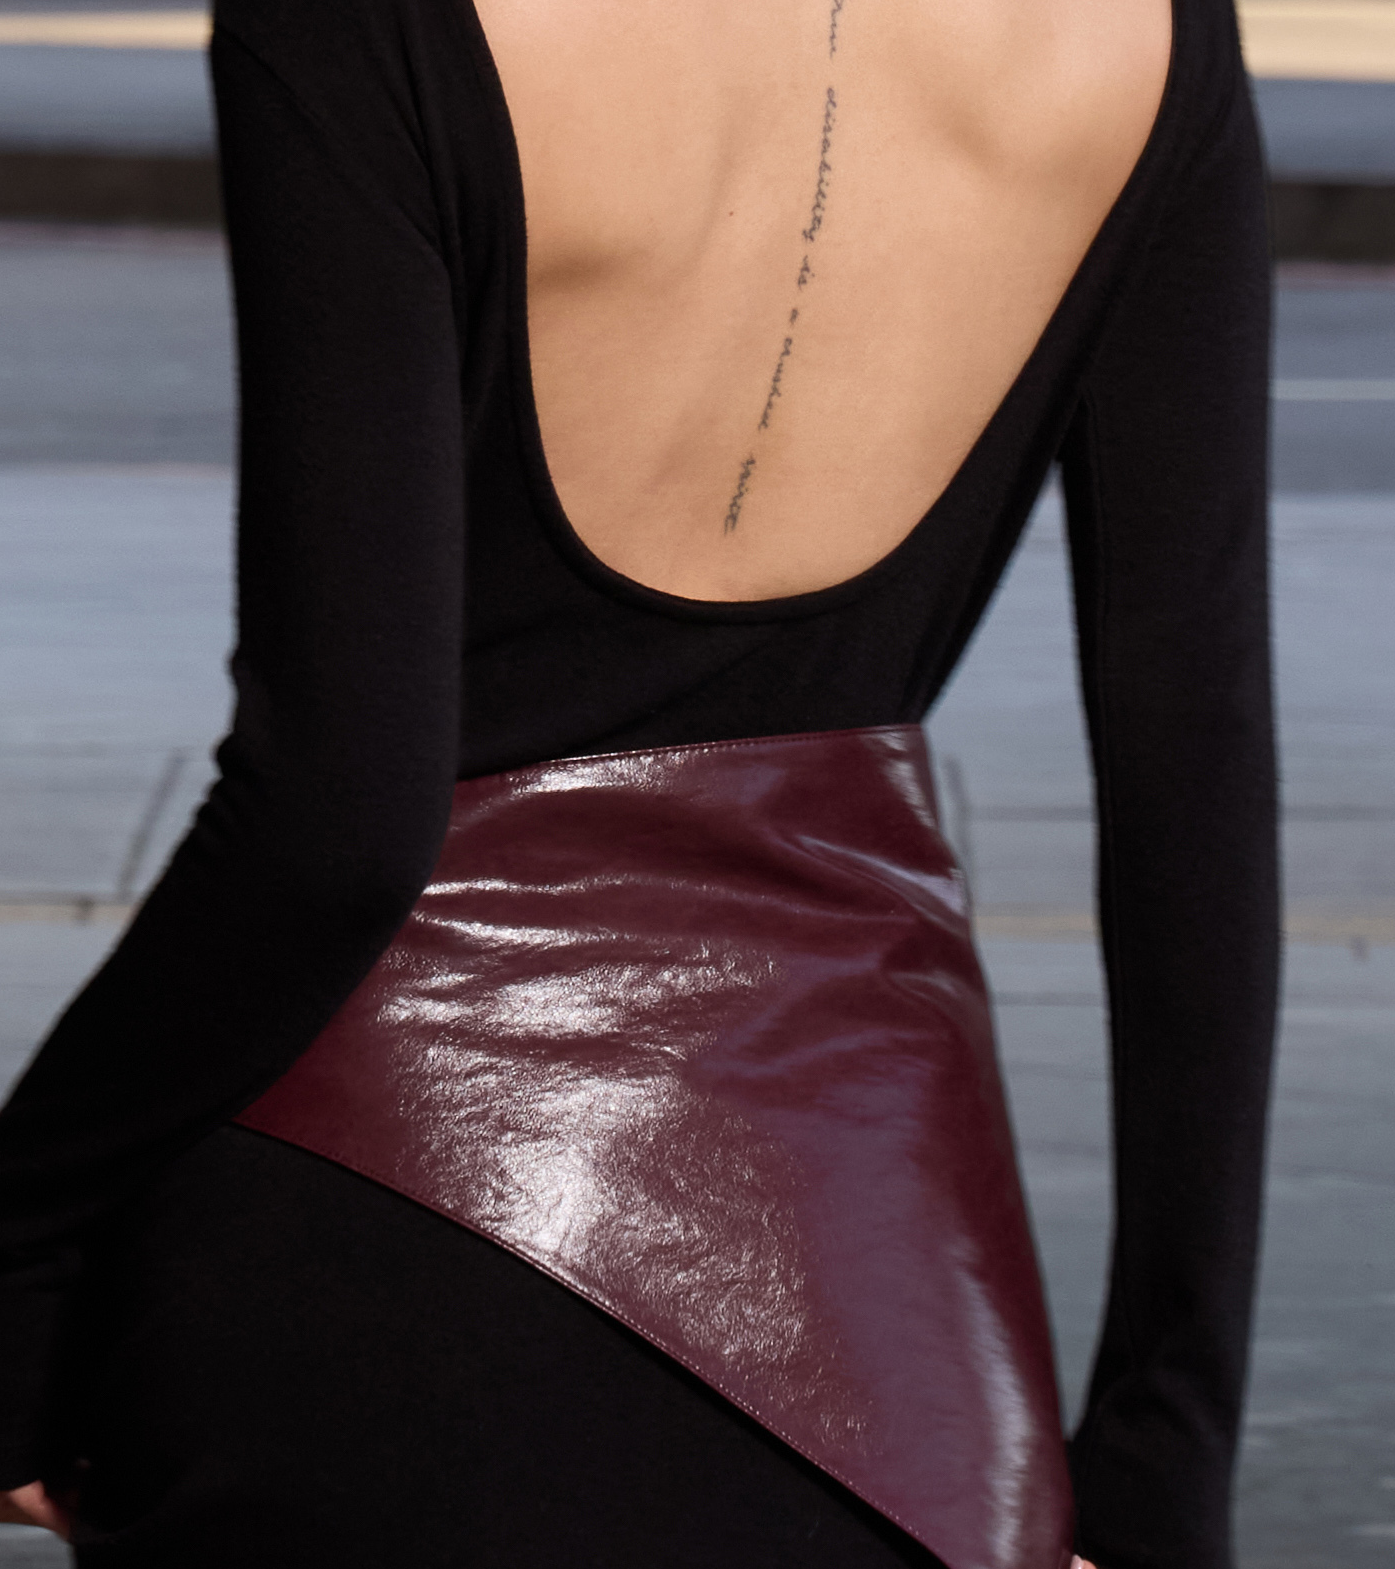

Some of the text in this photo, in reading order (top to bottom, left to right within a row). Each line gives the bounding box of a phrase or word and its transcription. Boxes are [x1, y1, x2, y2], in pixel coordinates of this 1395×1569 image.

[802, 86, 839, 243] disability
[796, 254, 816, 292] is
[789, 307, 800, 327] a
